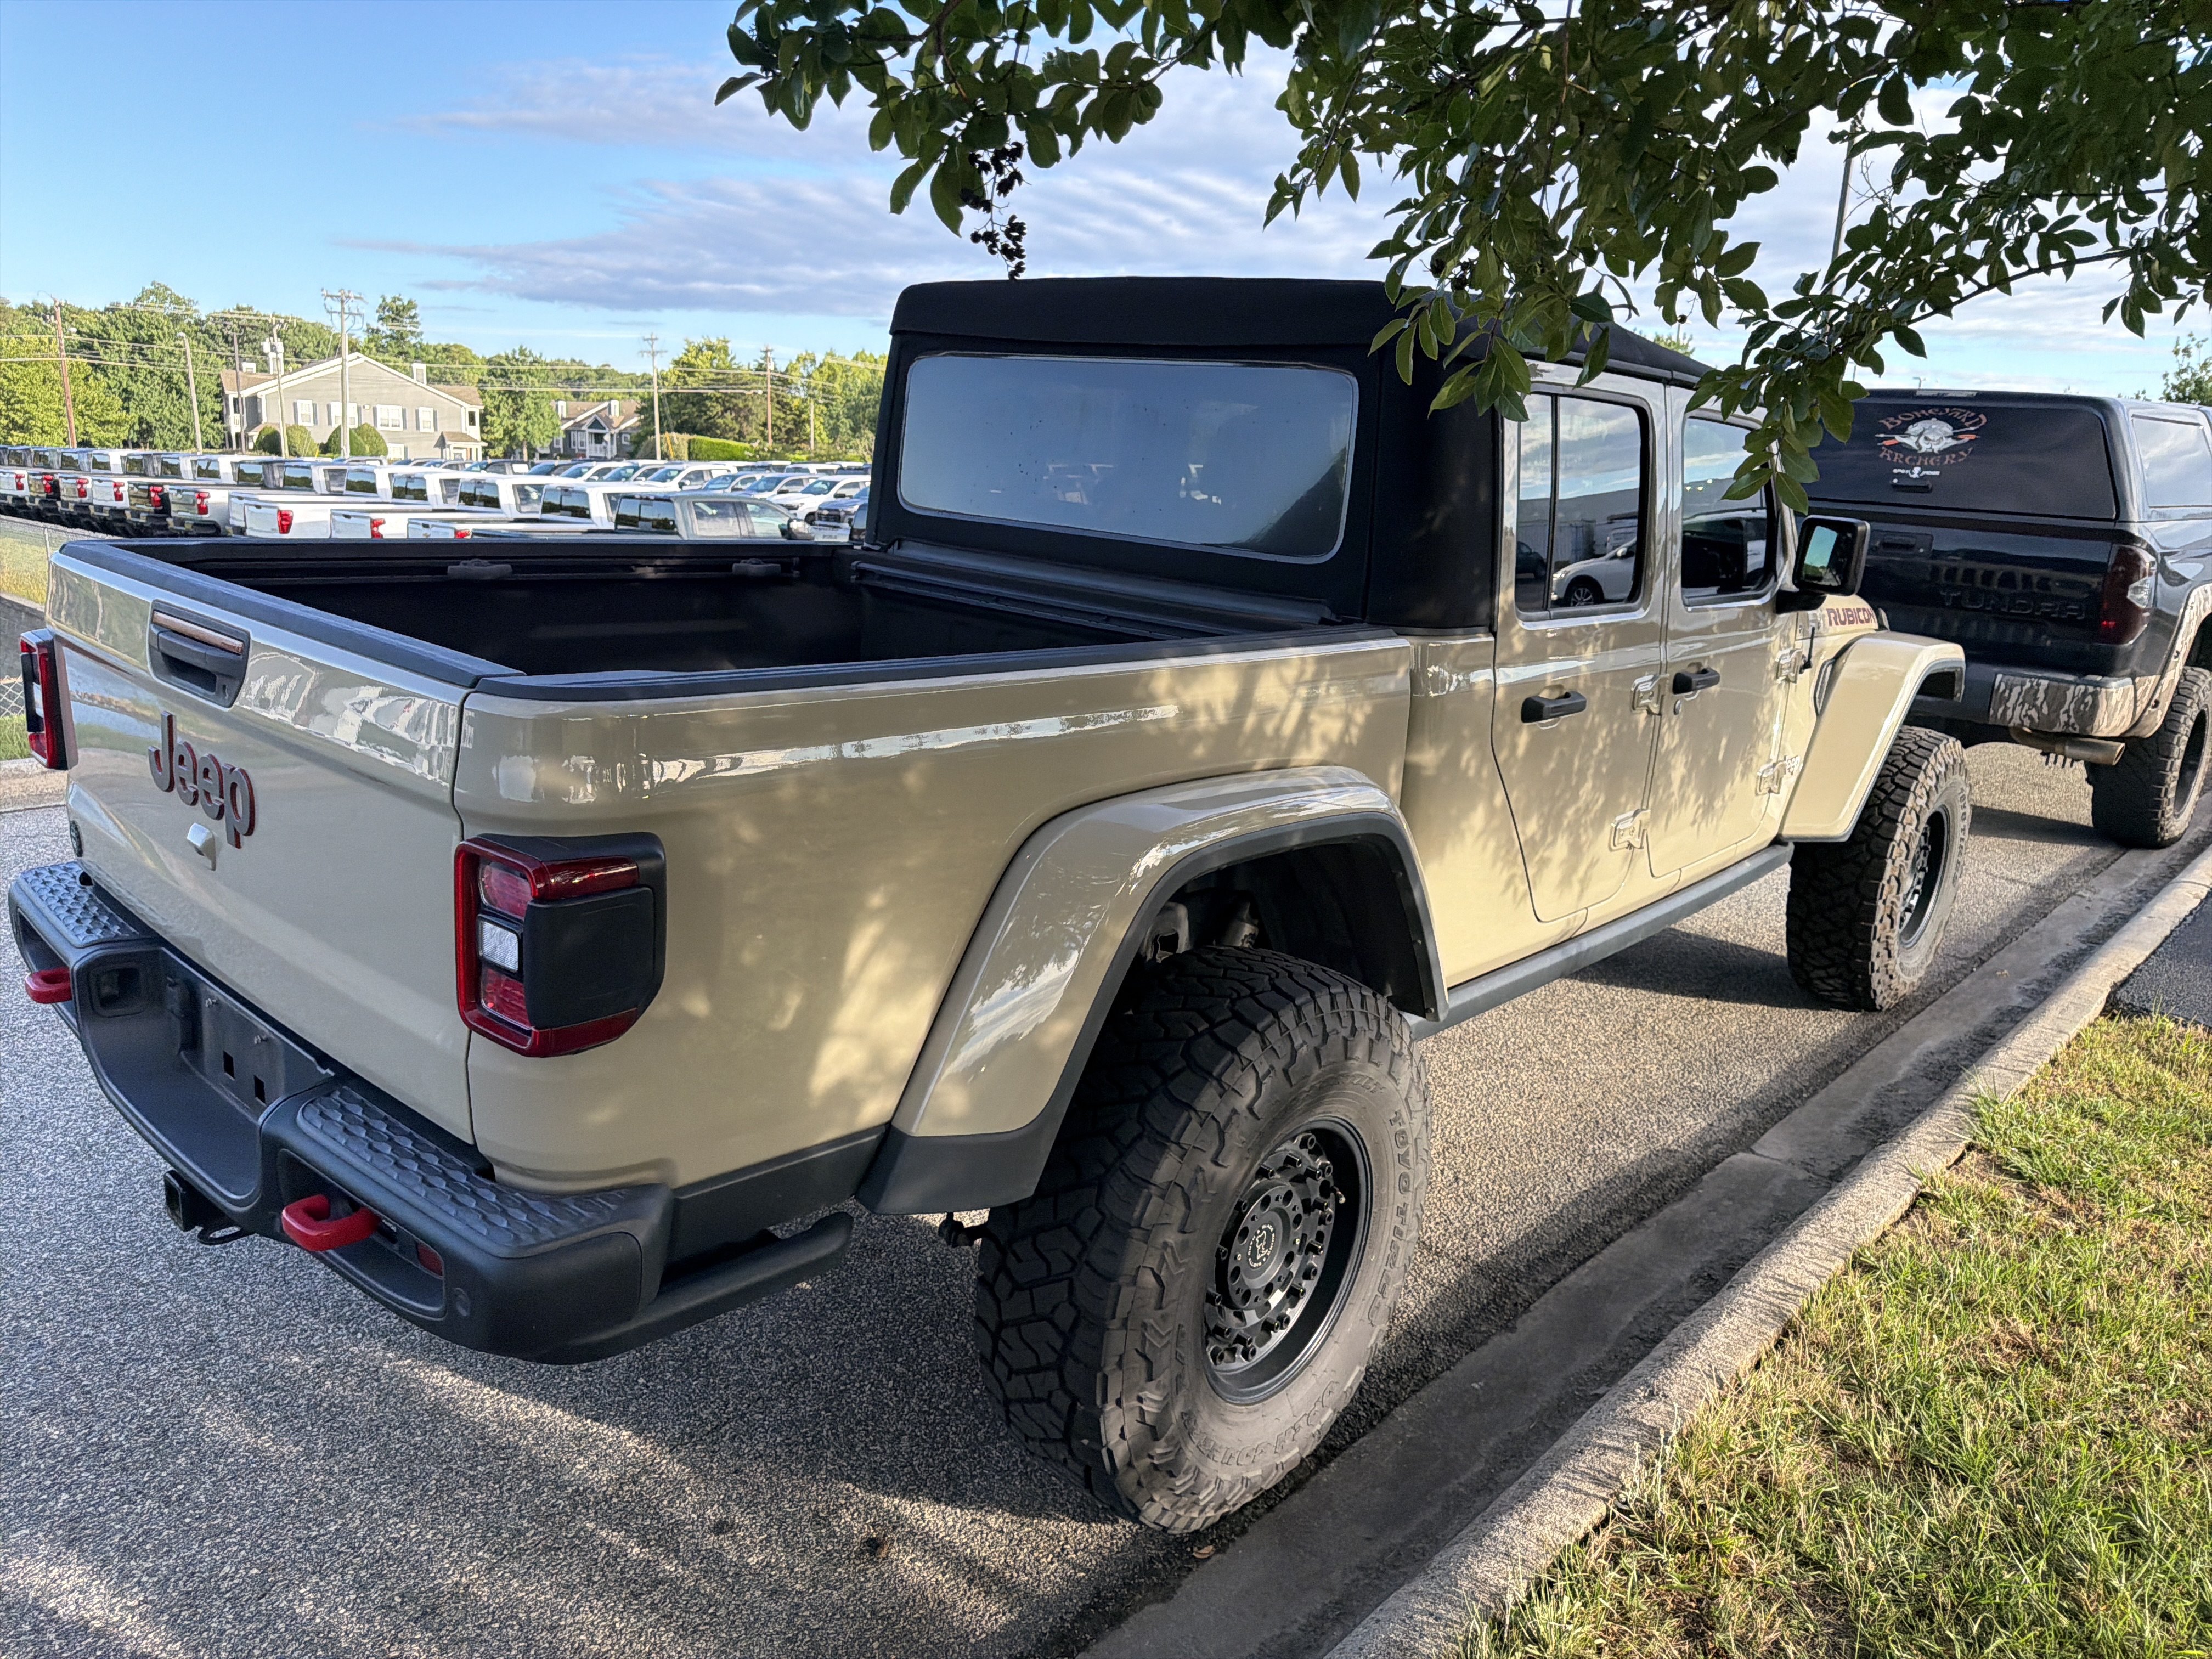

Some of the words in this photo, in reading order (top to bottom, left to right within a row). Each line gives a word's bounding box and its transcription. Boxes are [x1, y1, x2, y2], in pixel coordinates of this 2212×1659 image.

[1878, 407, 1988, 431] BONEYARD
[1878, 446, 1973, 466] ARCHERY
[1826, 607, 1876, 627] RUBICON
[1940, 589, 2085, 620] TUNDRA
[148, 710, 256, 849] Jeep
[1388, 1110, 1415, 1195] TOYO
[1367, 1201, 1409, 1328] TIRES
